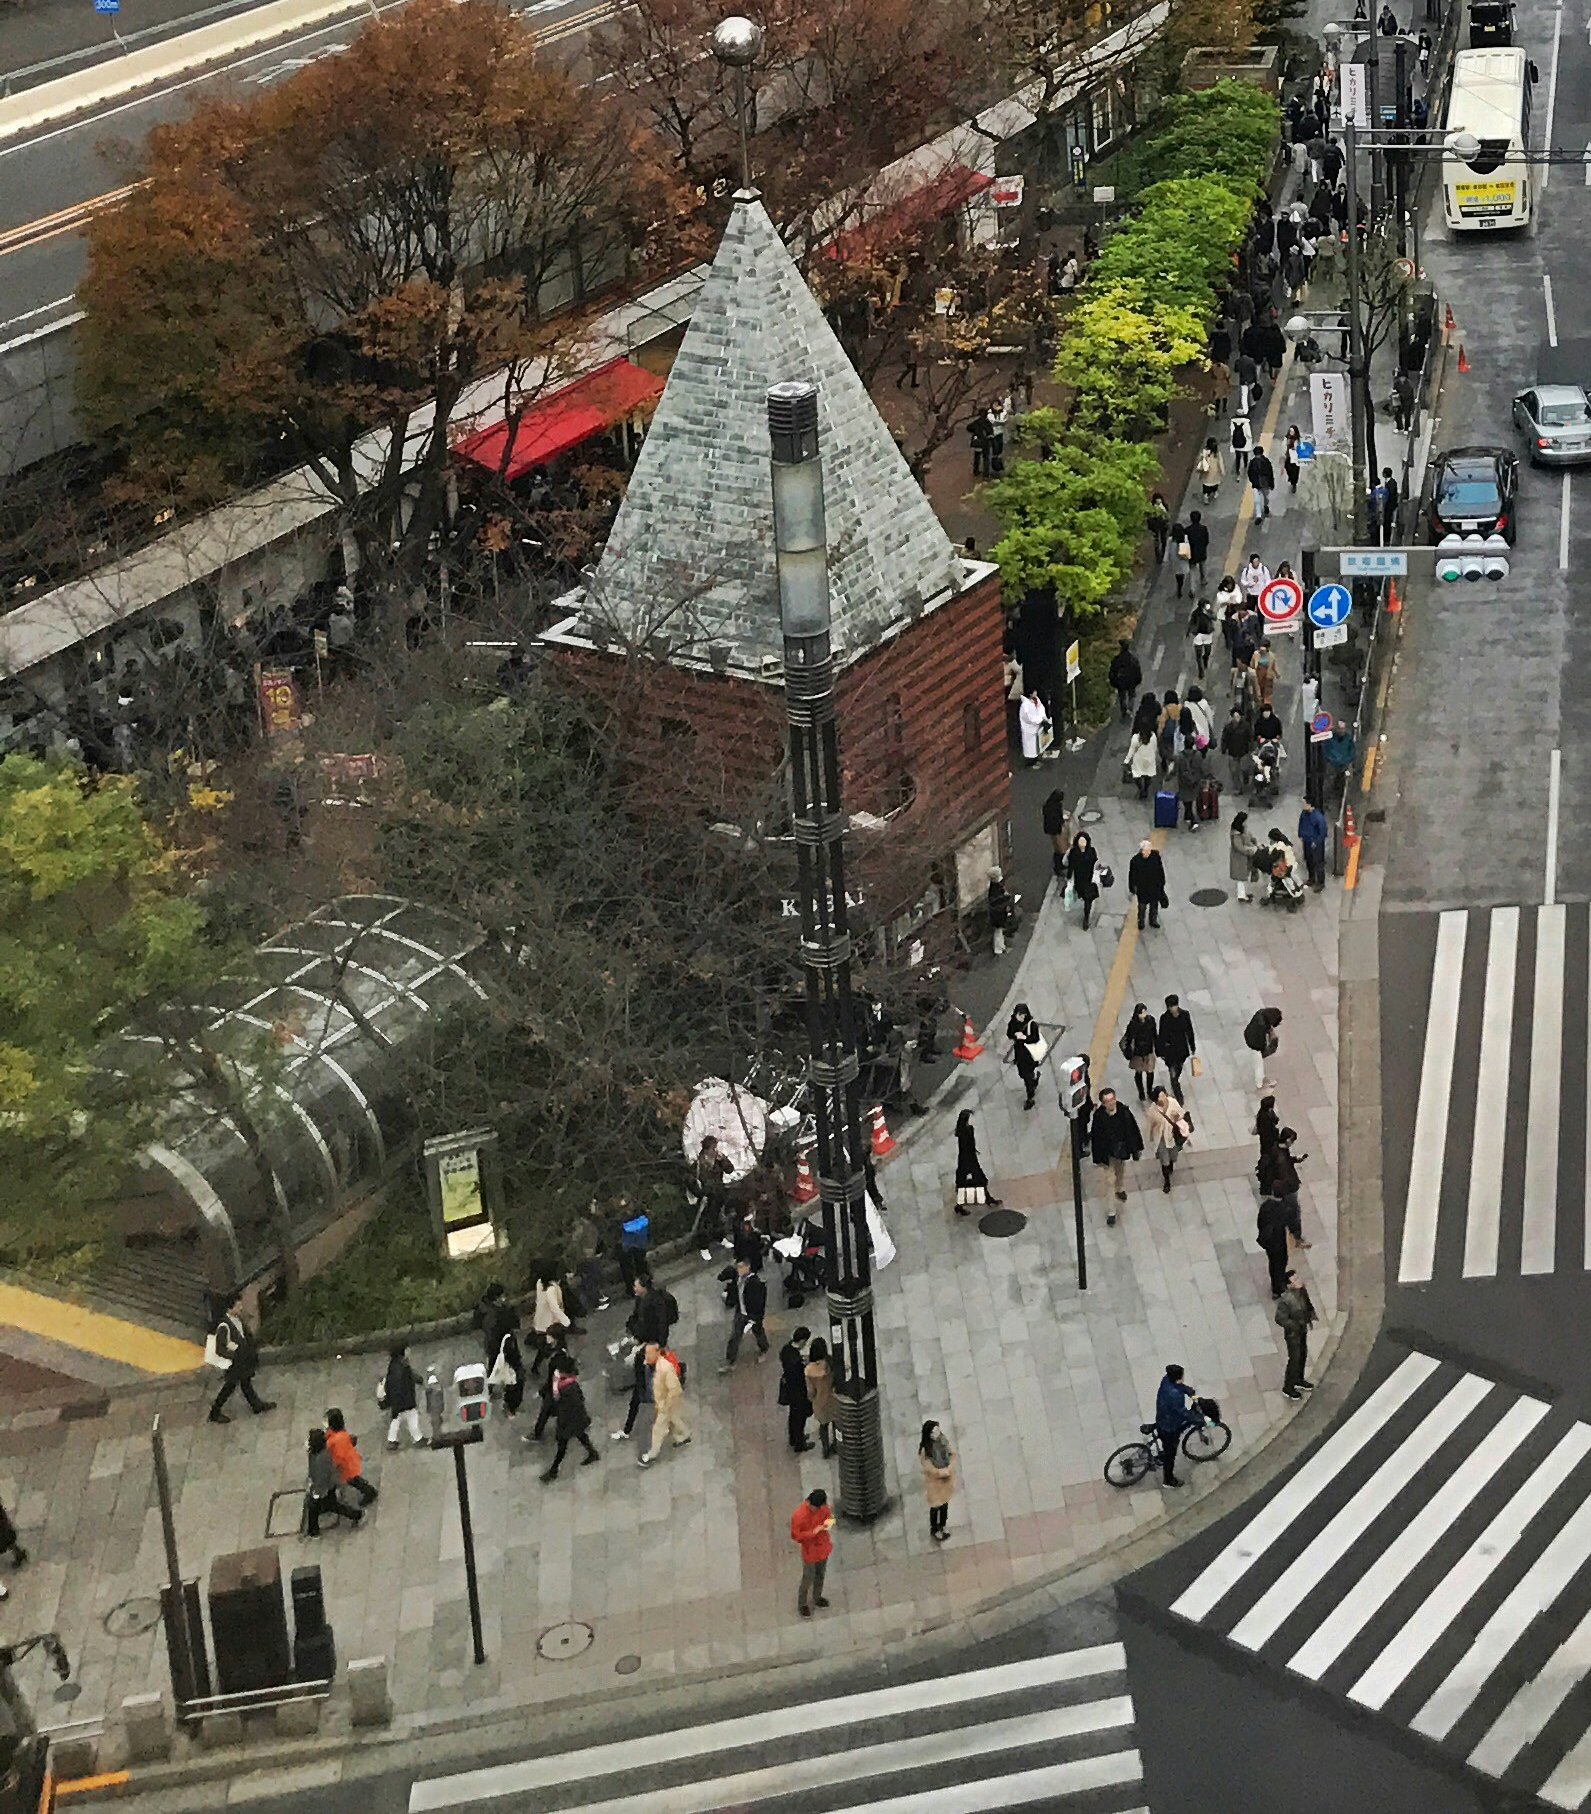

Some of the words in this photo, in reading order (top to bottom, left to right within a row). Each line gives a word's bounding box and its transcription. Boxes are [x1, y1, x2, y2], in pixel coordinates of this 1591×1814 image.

[1322, 378, 1336, 437] ヒカリミチ
